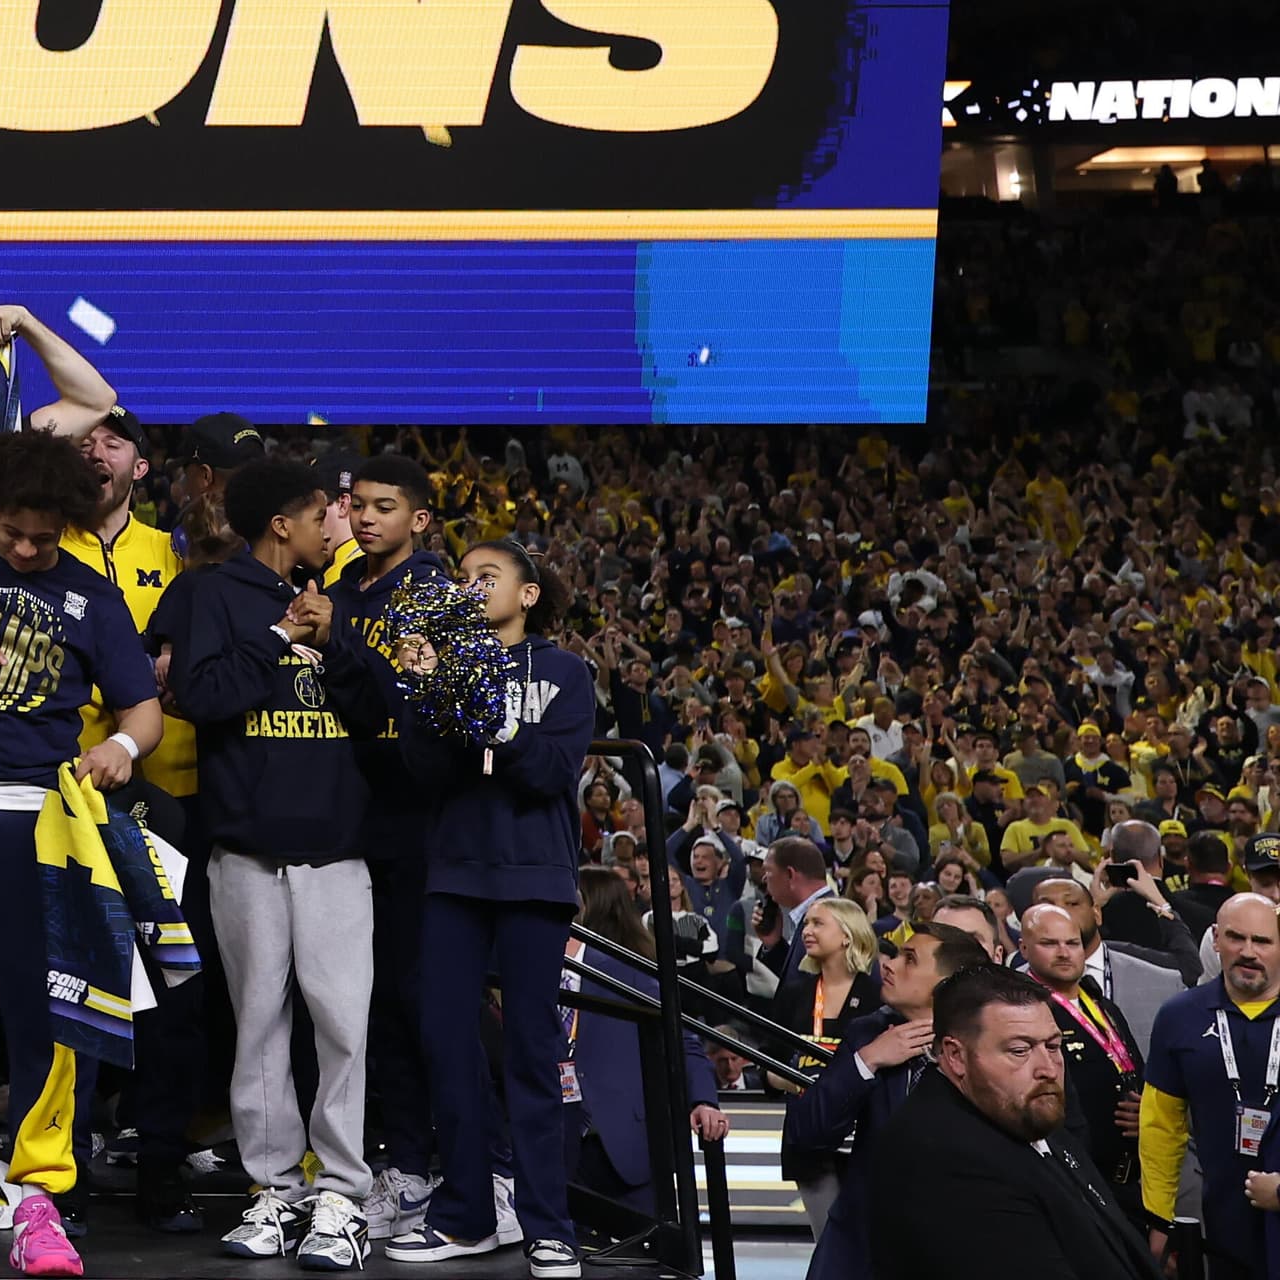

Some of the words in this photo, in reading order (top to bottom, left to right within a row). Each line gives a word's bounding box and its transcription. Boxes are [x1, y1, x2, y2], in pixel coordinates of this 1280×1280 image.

[136, 568, 163, 588] M
[47, 970, 88, 993] ENDS
[49, 983, 81, 1005] THE
